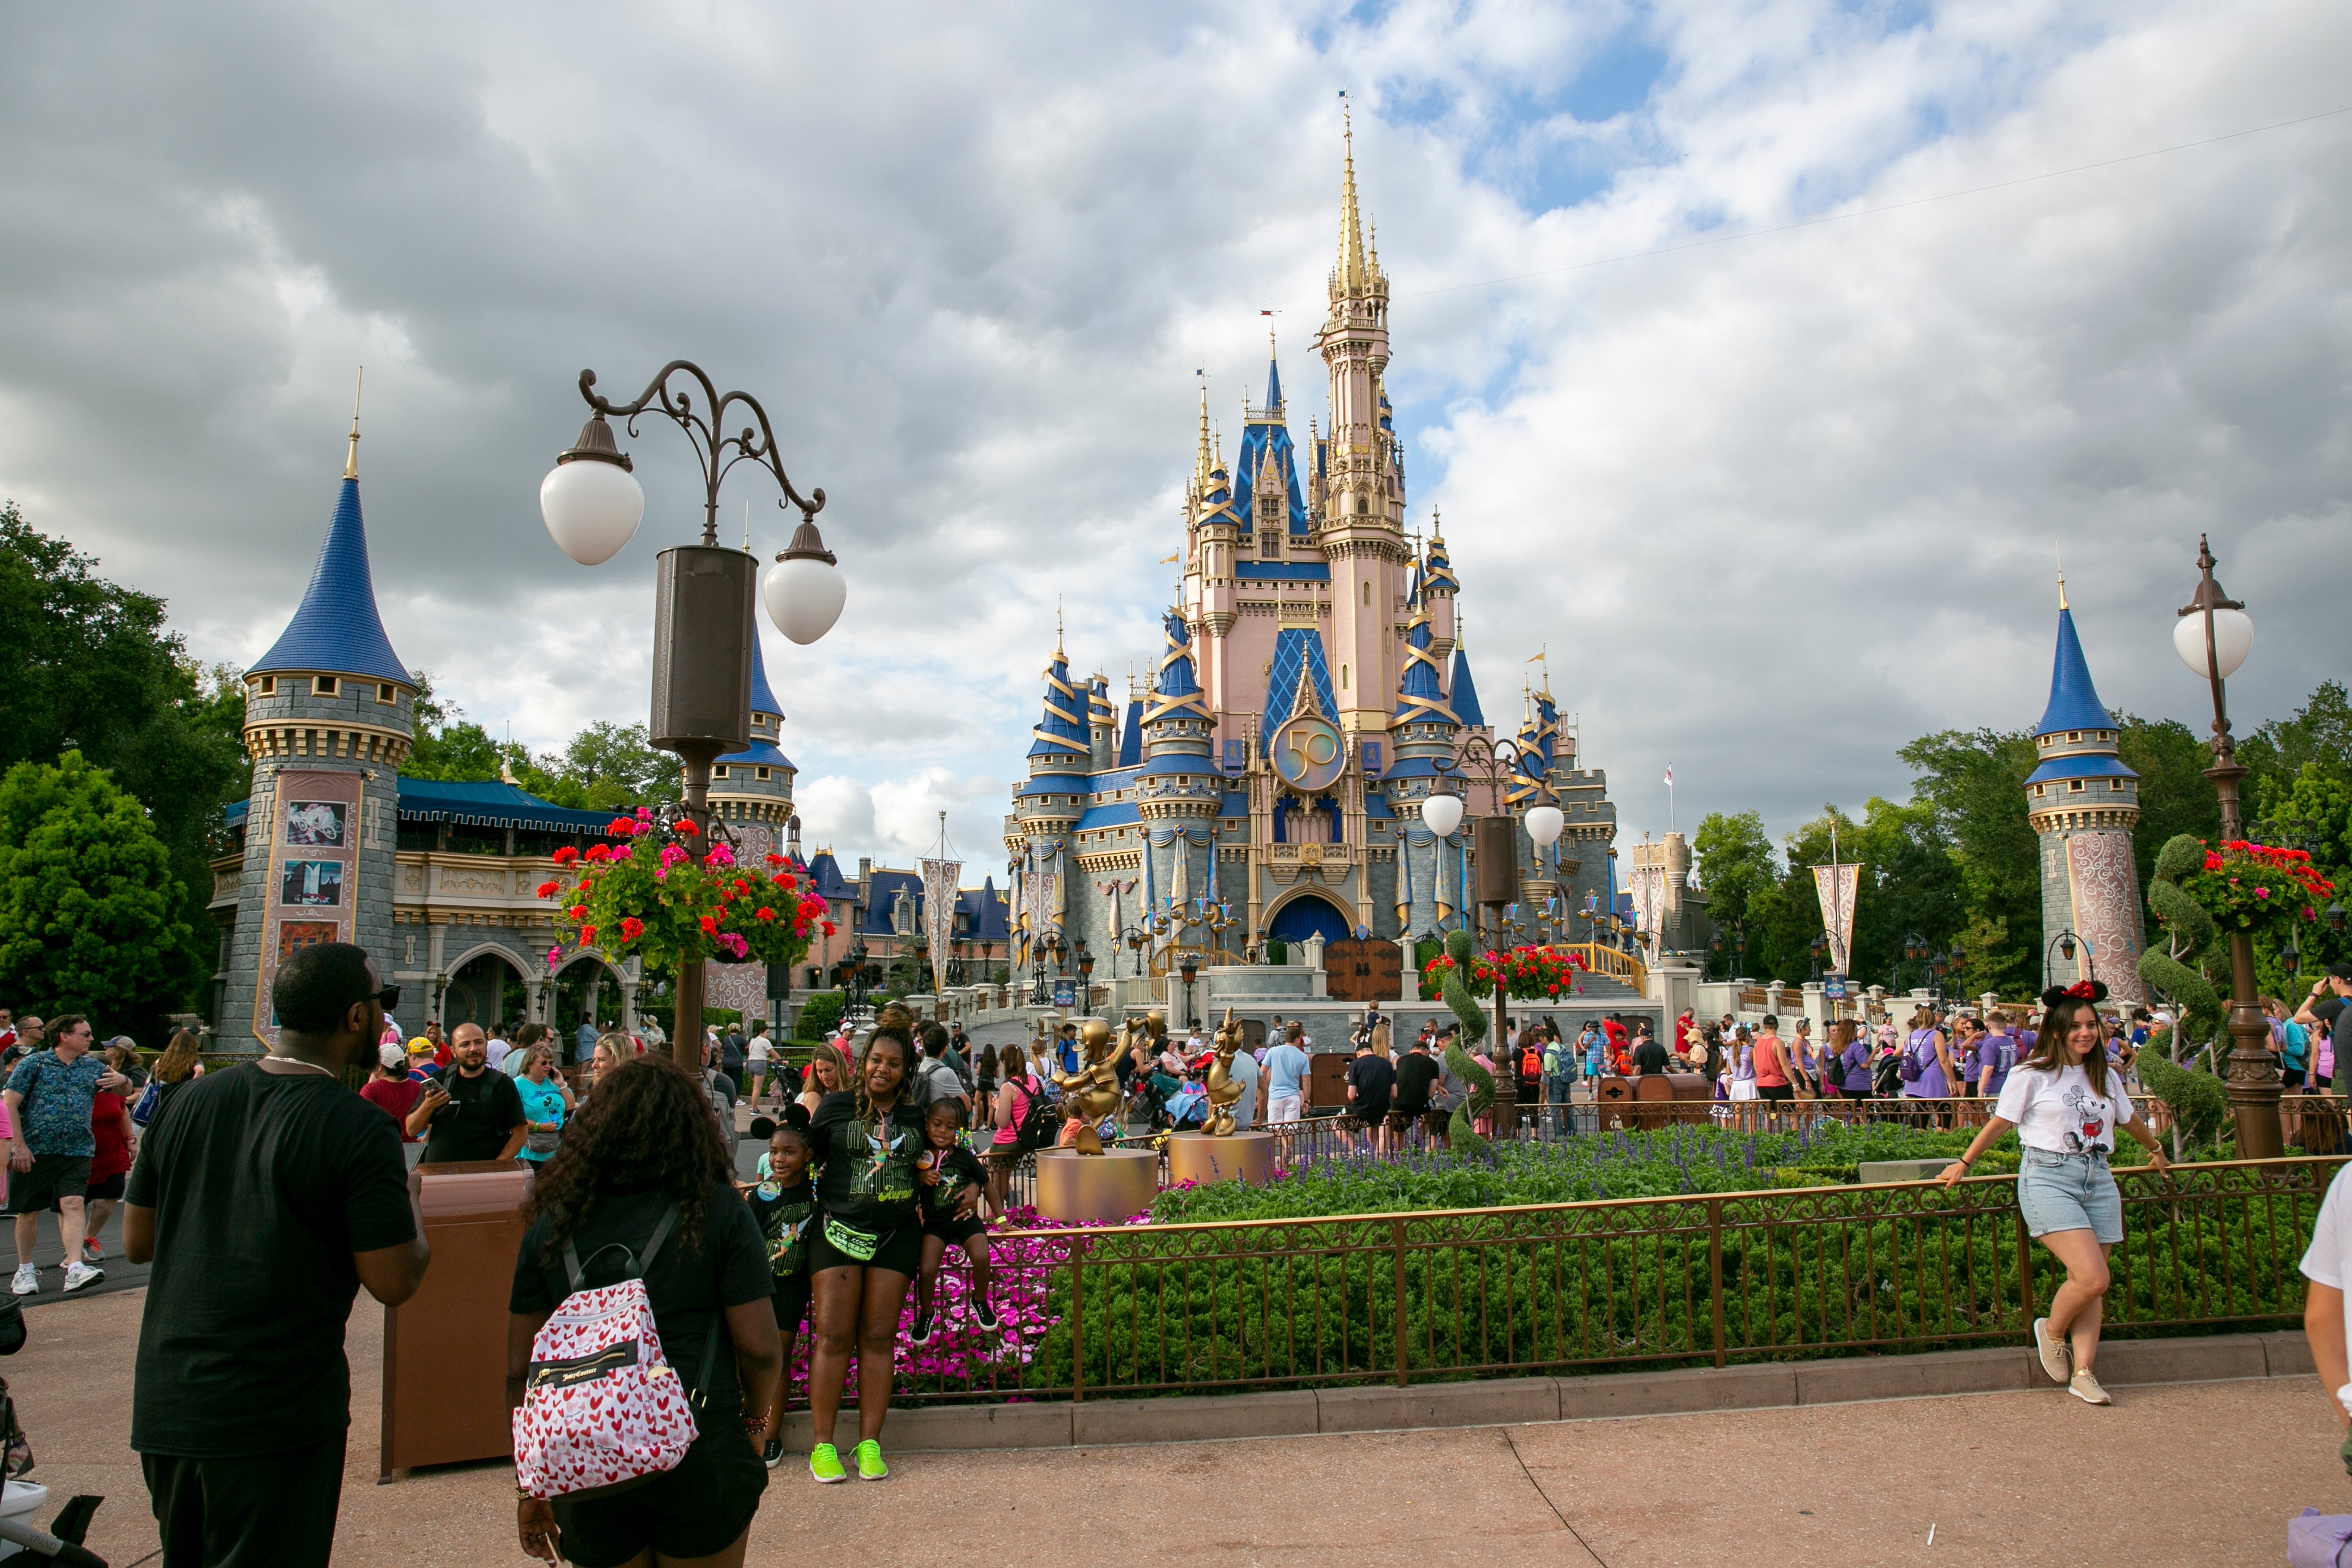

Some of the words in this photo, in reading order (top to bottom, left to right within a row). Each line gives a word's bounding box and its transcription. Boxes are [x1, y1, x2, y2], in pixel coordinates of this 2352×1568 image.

[1289, 729, 1337, 782] 50
[2098, 933, 2125, 960] 50
[27, 1534, 57, 1550] XPAND
